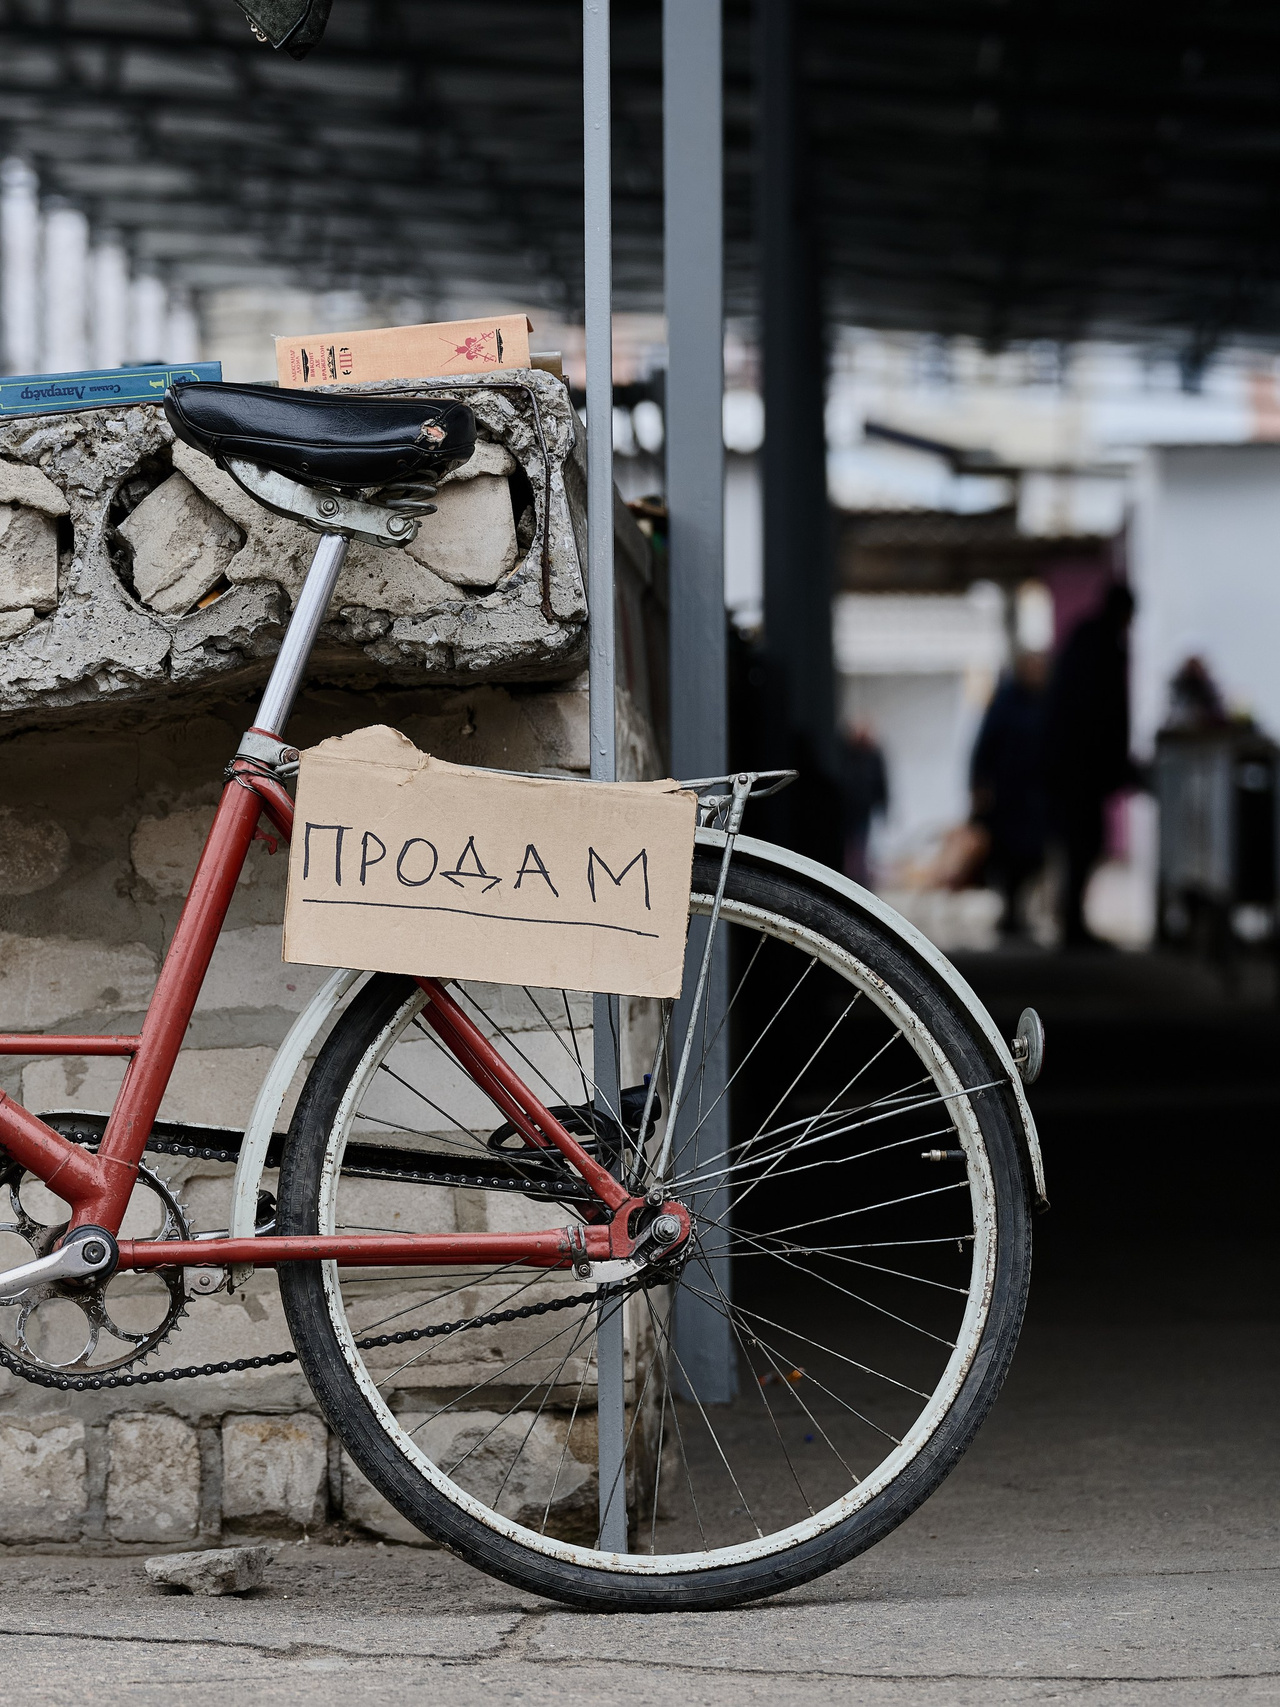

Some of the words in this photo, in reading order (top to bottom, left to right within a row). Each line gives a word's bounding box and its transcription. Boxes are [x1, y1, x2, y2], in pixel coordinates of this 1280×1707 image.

[20, 384, 86, 401] Лагерлёф
[89, 384, 121, 394] Сельма
[303, 822, 651, 910] ПРОДАМ
[898, 1456, 925, 1486] USSR
